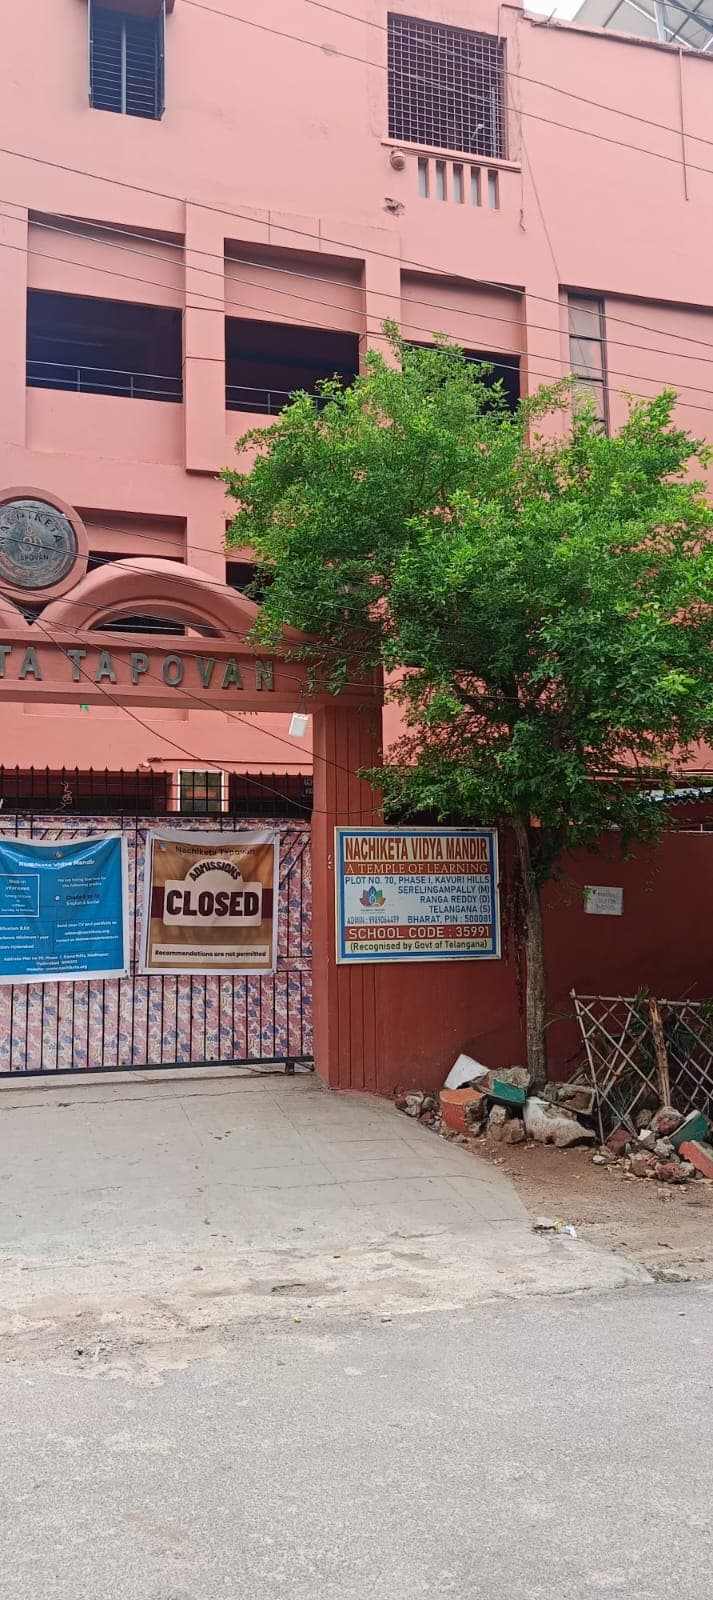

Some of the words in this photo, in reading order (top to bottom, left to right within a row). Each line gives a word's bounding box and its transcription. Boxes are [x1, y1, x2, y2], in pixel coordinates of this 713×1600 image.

[67, 649, 275, 692] TAPOVAN
[175, 846, 217, 856] Nachiketa
[345, 838, 408, 860] NACHIKETA
[412, 838, 443, 860] VIDYA
[446, 838, 487, 860] MANDIR
[189, 861, 241, 882] ADMISSIONS
[346, 864, 354, 874] A
[358, 864, 405, 874] TEMPLE
[408, 864, 424, 873] OF
[427, 864, 489, 873] LEARNING
[384, 877, 396, 885] 70,
[398, 886, 476, 895] SERELINGAMPALLY
[478, 886, 490, 895] (M)
[166, 890, 259, 916] CLOSED
[420, 895, 447, 903] RANGA
[451, 895, 477, 903] REDDY
[480, 895, 490, 904] (D)
[429, 905, 478, 913] TELANGANA
[480, 905, 490, 913] (S)
[407, 915, 442, 924] BHARAT,
[444, 915, 458, 923] PIN
[465, 915, 491, 923] 500081
[349, 928, 404, 939] SCHOOL
[409, 927, 444, 938] CODE
[456, 926, 489, 937] 35991
[350, 942, 400, 952] (Recognised
[403, 941, 412, 950] by
[414, 940, 432, 949] Govt
[434, 940, 442, 948] of
[445, 940, 487, 950] Telangana)
